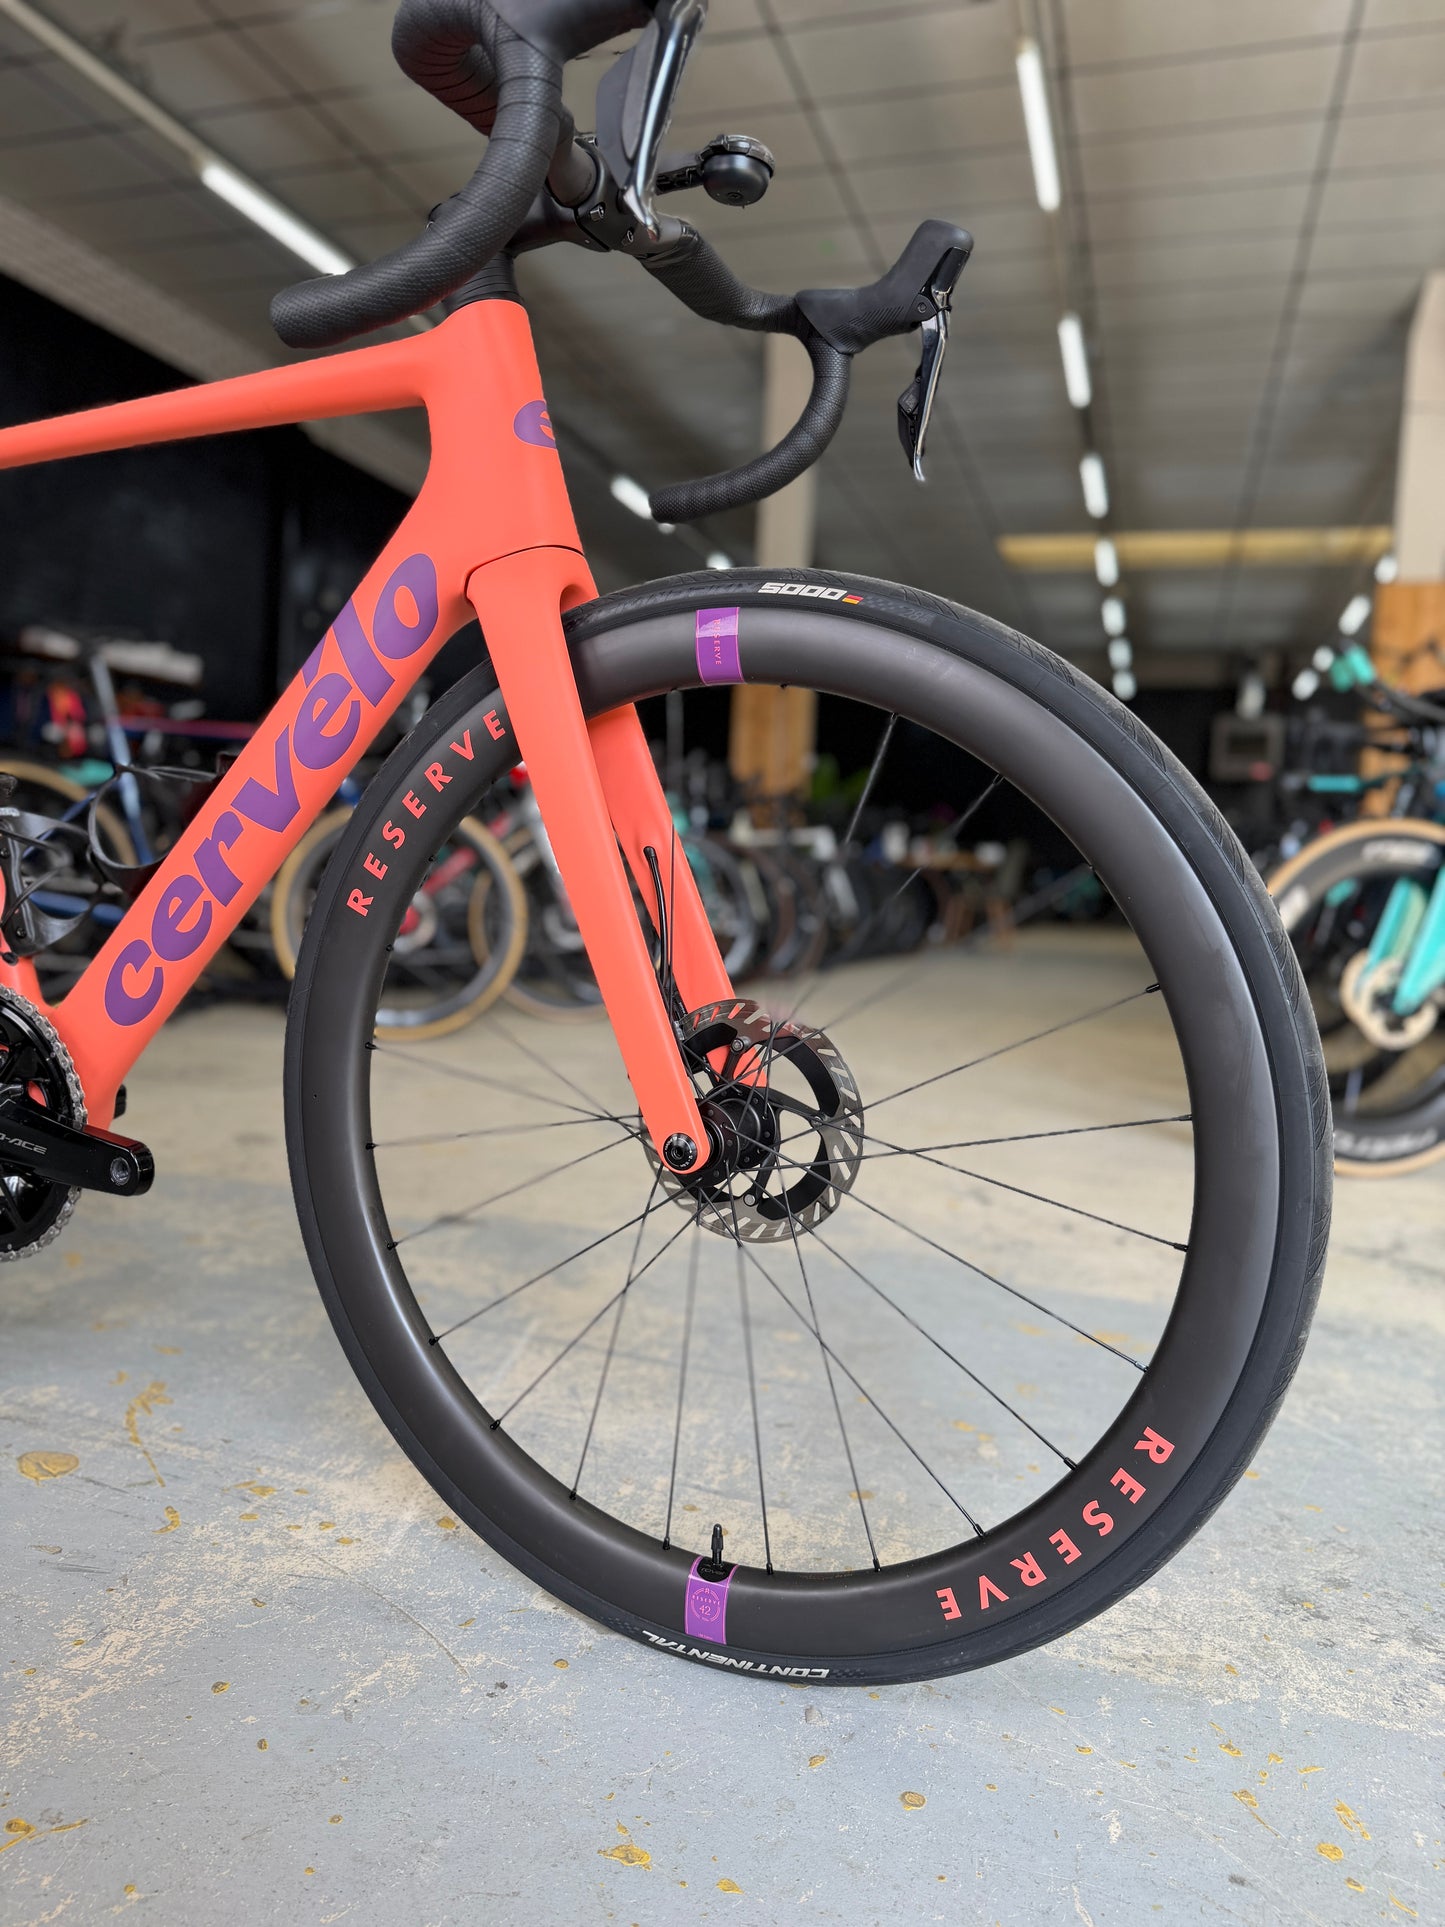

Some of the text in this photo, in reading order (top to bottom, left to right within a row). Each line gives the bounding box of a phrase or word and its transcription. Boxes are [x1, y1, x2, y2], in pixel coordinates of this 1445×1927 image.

[758, 582, 848, 601] 5000
[713, 619, 722, 665] RESERVE
[104, 553, 439, 1027] cervélo
[346, 709, 506, 917] RESERVE
[934, 1426, 1176, 1621] RESERVE
[699, 1605, 711, 1616] 42
[642, 1630, 830, 1679] CONTINENTAL
